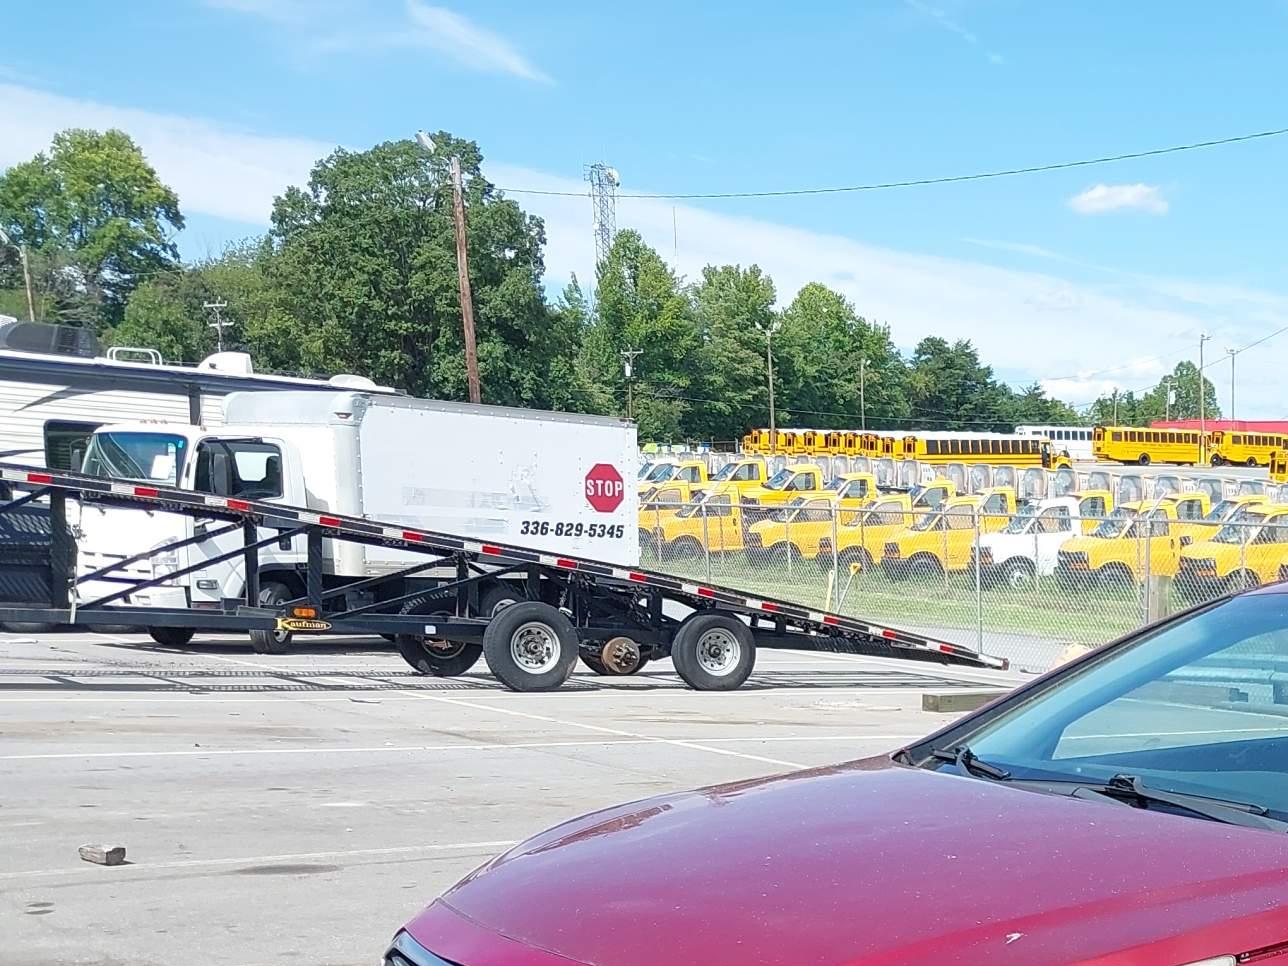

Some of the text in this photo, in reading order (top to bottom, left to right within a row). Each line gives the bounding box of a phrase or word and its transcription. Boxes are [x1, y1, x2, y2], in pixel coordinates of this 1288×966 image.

[585, 480, 624, 497] STOP
[520, 521, 625, 538] 336-829-5345
[274, 617, 328, 631] Kaufman
